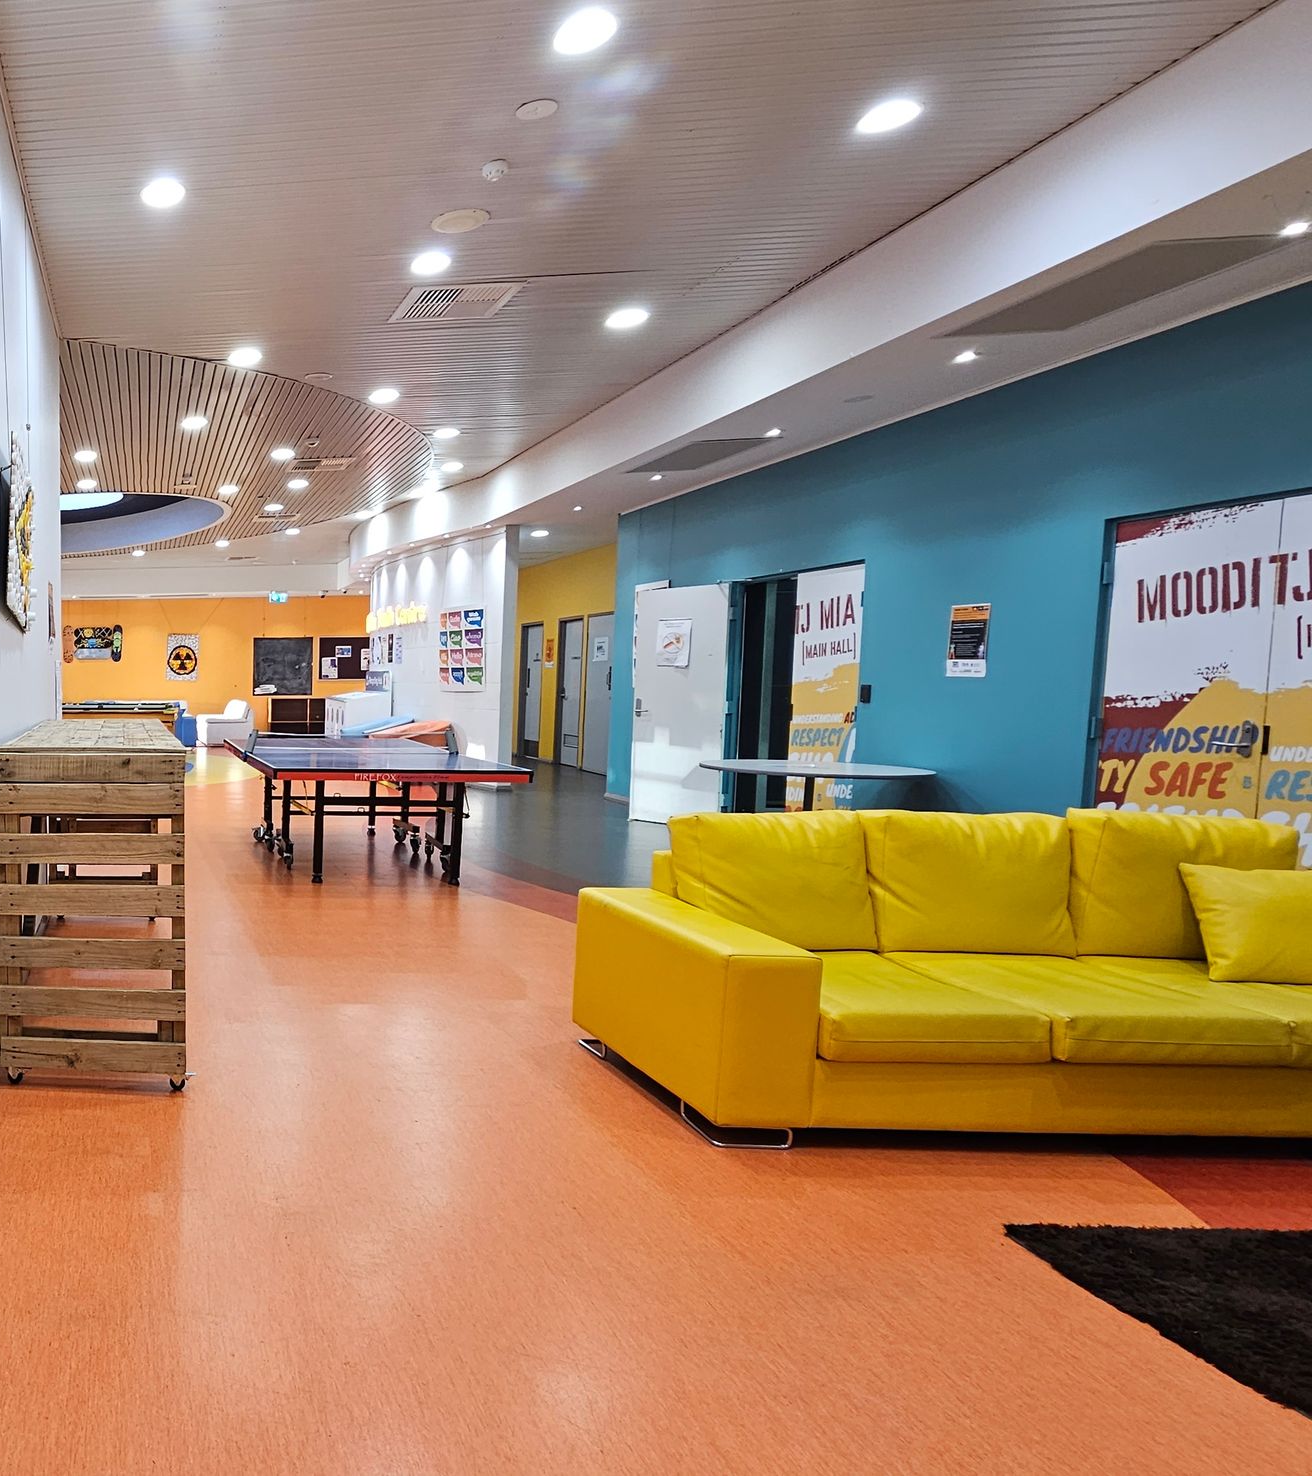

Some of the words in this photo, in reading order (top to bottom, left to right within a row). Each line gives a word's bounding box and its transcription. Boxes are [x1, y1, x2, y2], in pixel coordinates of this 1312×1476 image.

[820, 594, 855, 631] MIA
[791, 727, 845, 747] RESPECT
[354, 773, 397, 782] FIREFOX
[1099, 759, 1136, 793] TY
[1144, 761, 1233, 799] SAFE
[1265, 769, 1312, 802] RE
[826, 784, 853, 799] UNDE
